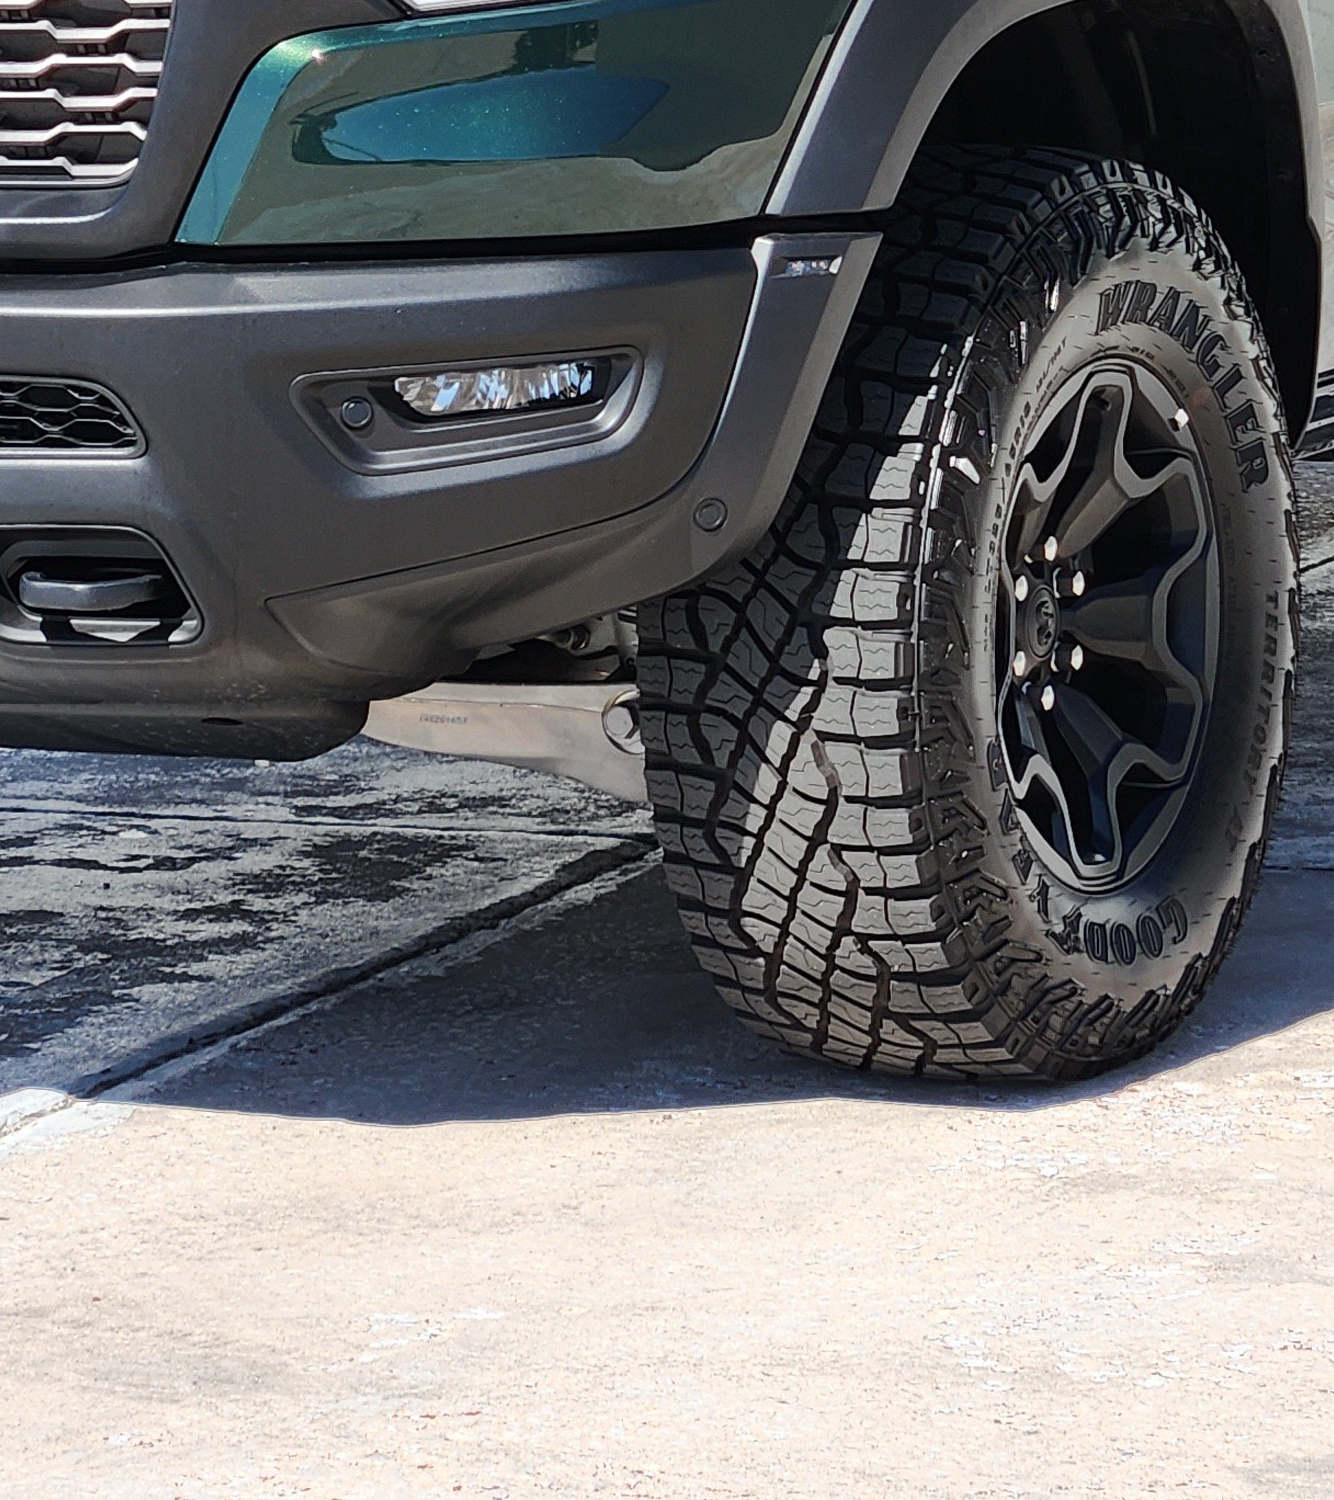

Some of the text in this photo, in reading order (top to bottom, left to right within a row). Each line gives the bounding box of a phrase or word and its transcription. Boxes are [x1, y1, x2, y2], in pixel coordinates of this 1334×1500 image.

[1095, 280, 1269, 493] WRANGLER
[1244, 590, 1279, 795] TERRITORY
[986, 738, 1188, 966] GOODYEAR
